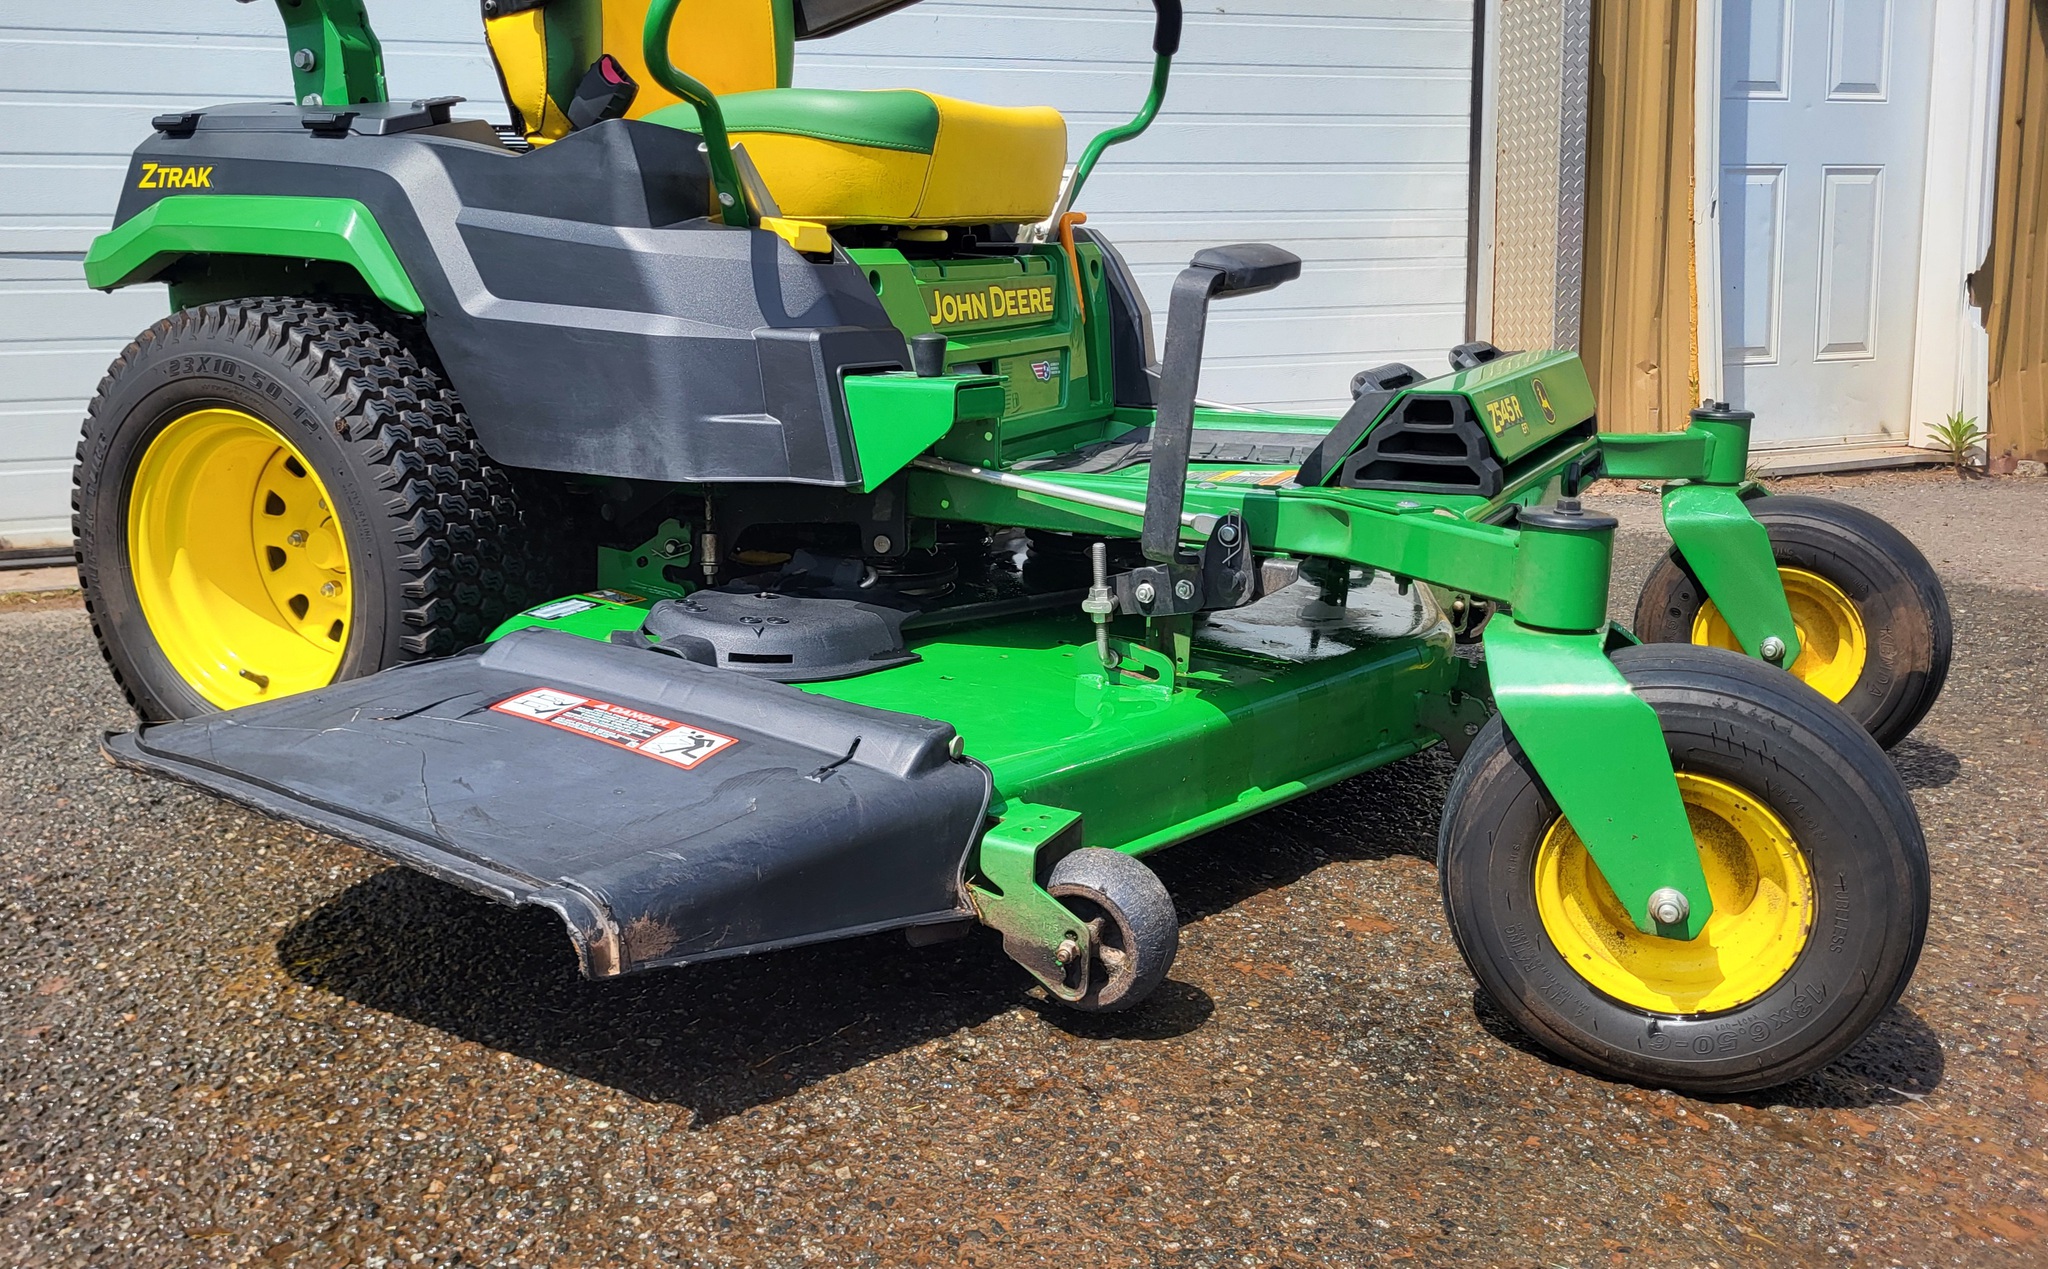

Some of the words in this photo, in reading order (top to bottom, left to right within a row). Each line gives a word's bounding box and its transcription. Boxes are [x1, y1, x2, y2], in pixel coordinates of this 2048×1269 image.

[138, 163, 213, 189] ZTRAK
[930, 290, 988, 325] JOHN
[989, 285, 1055, 318] DEERE
[1486, 395, 1524, 433] Z545R
[1868, 625, 1898, 698] KENDA
[609, 706, 671, 726] DANGER
[1770, 782, 1828, 844] NYLON
[1829, 878, 1851, 955] TUBELESS
[1503, 923, 1538, 973] RATING
[1539, 983, 1567, 1008] PLY
